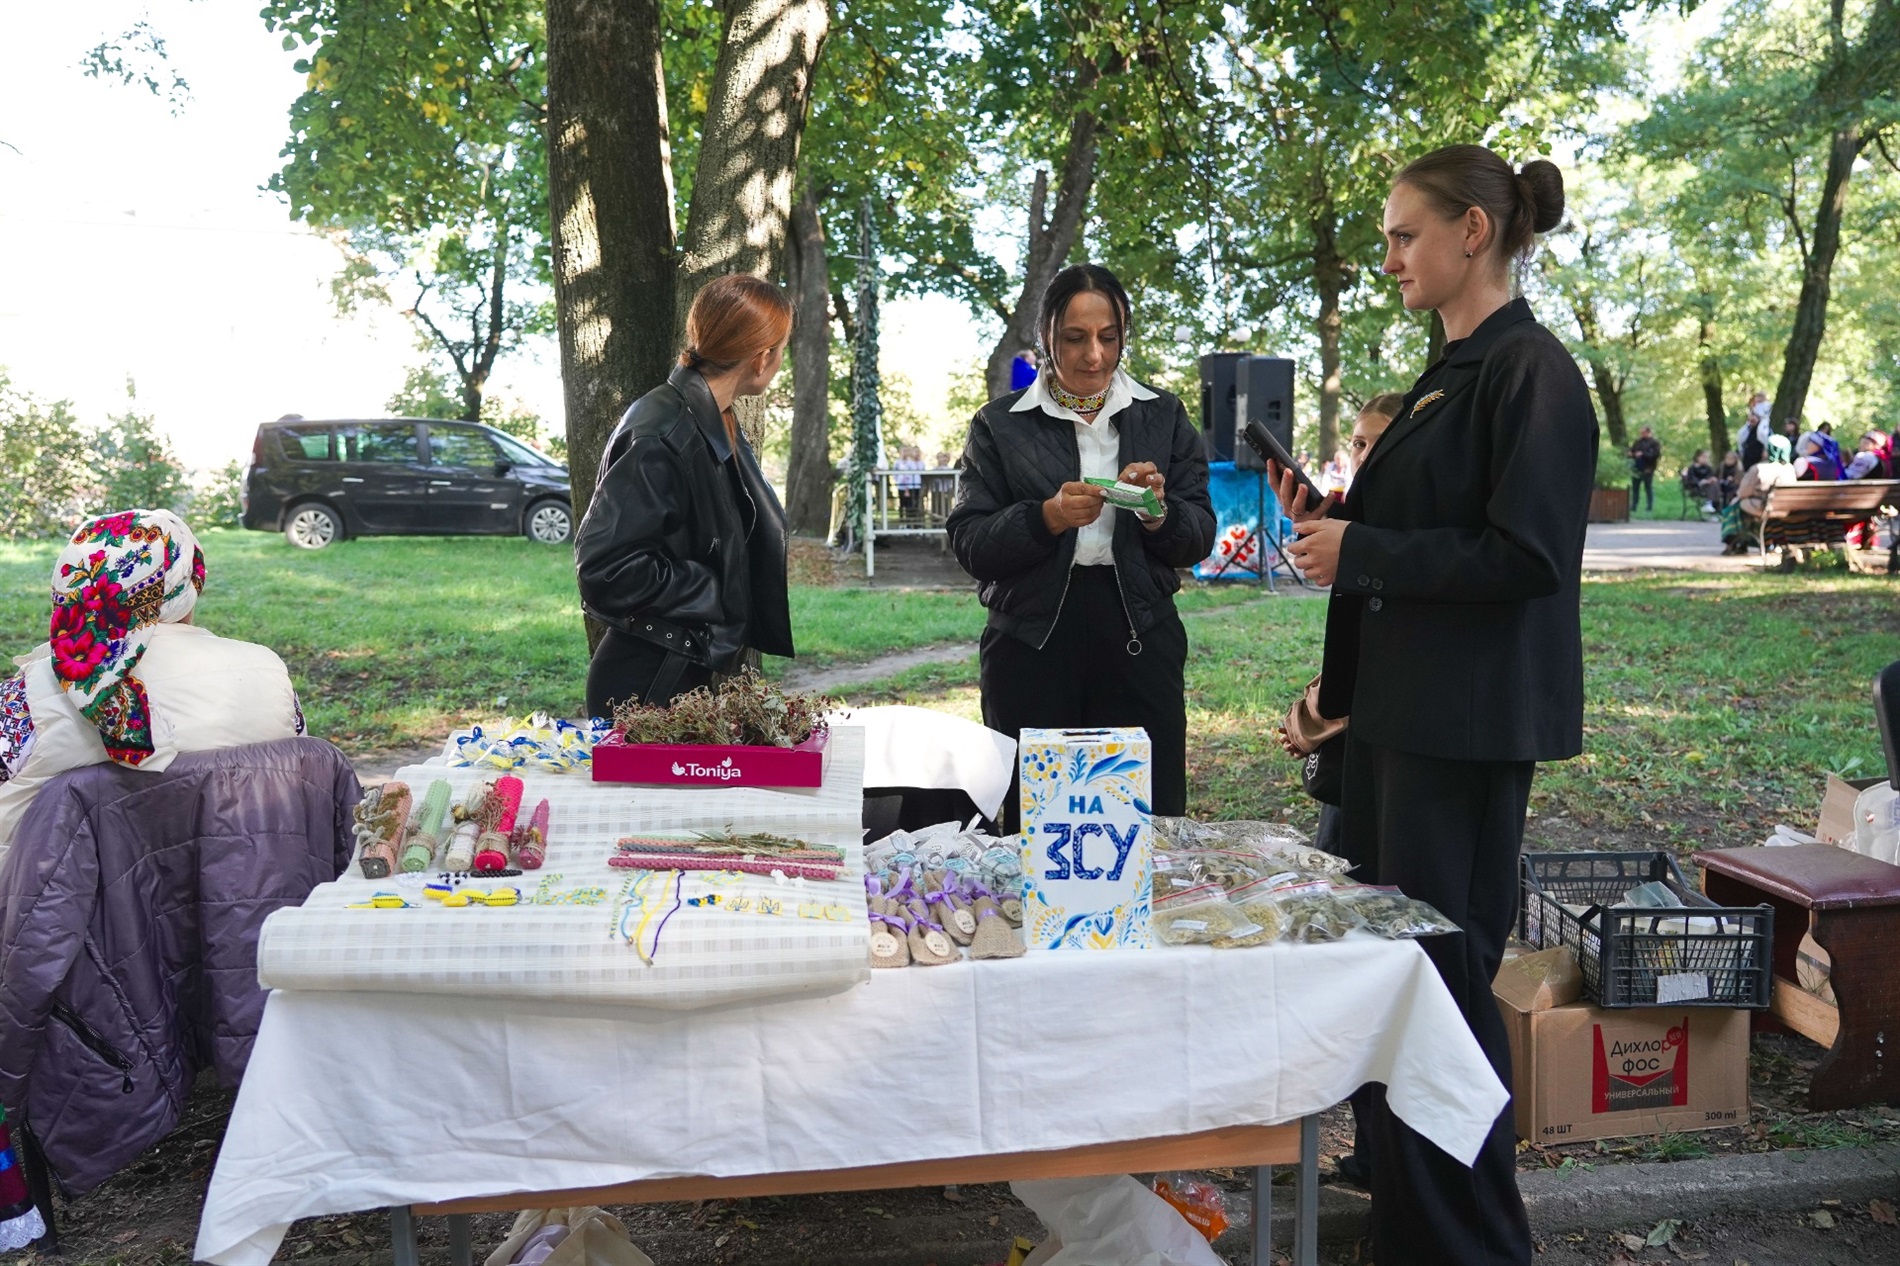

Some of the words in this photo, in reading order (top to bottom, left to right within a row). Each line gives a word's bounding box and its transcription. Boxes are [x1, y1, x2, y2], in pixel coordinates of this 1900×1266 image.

[686, 762, 741, 780] Toniya
[1069, 796, 1104, 814] НА
[1043, 823, 1140, 881] ЗСУ
[1610, 1040, 1673, 1057] Дихлор
[1604, 1085, 1680, 1100] УНИВЕРСАЛЬНЫЙ
[1705, 1111, 1722, 1121] 300
[1724, 1110, 1737, 1120] ml
[1542, 1125, 1555, 1135] 48
